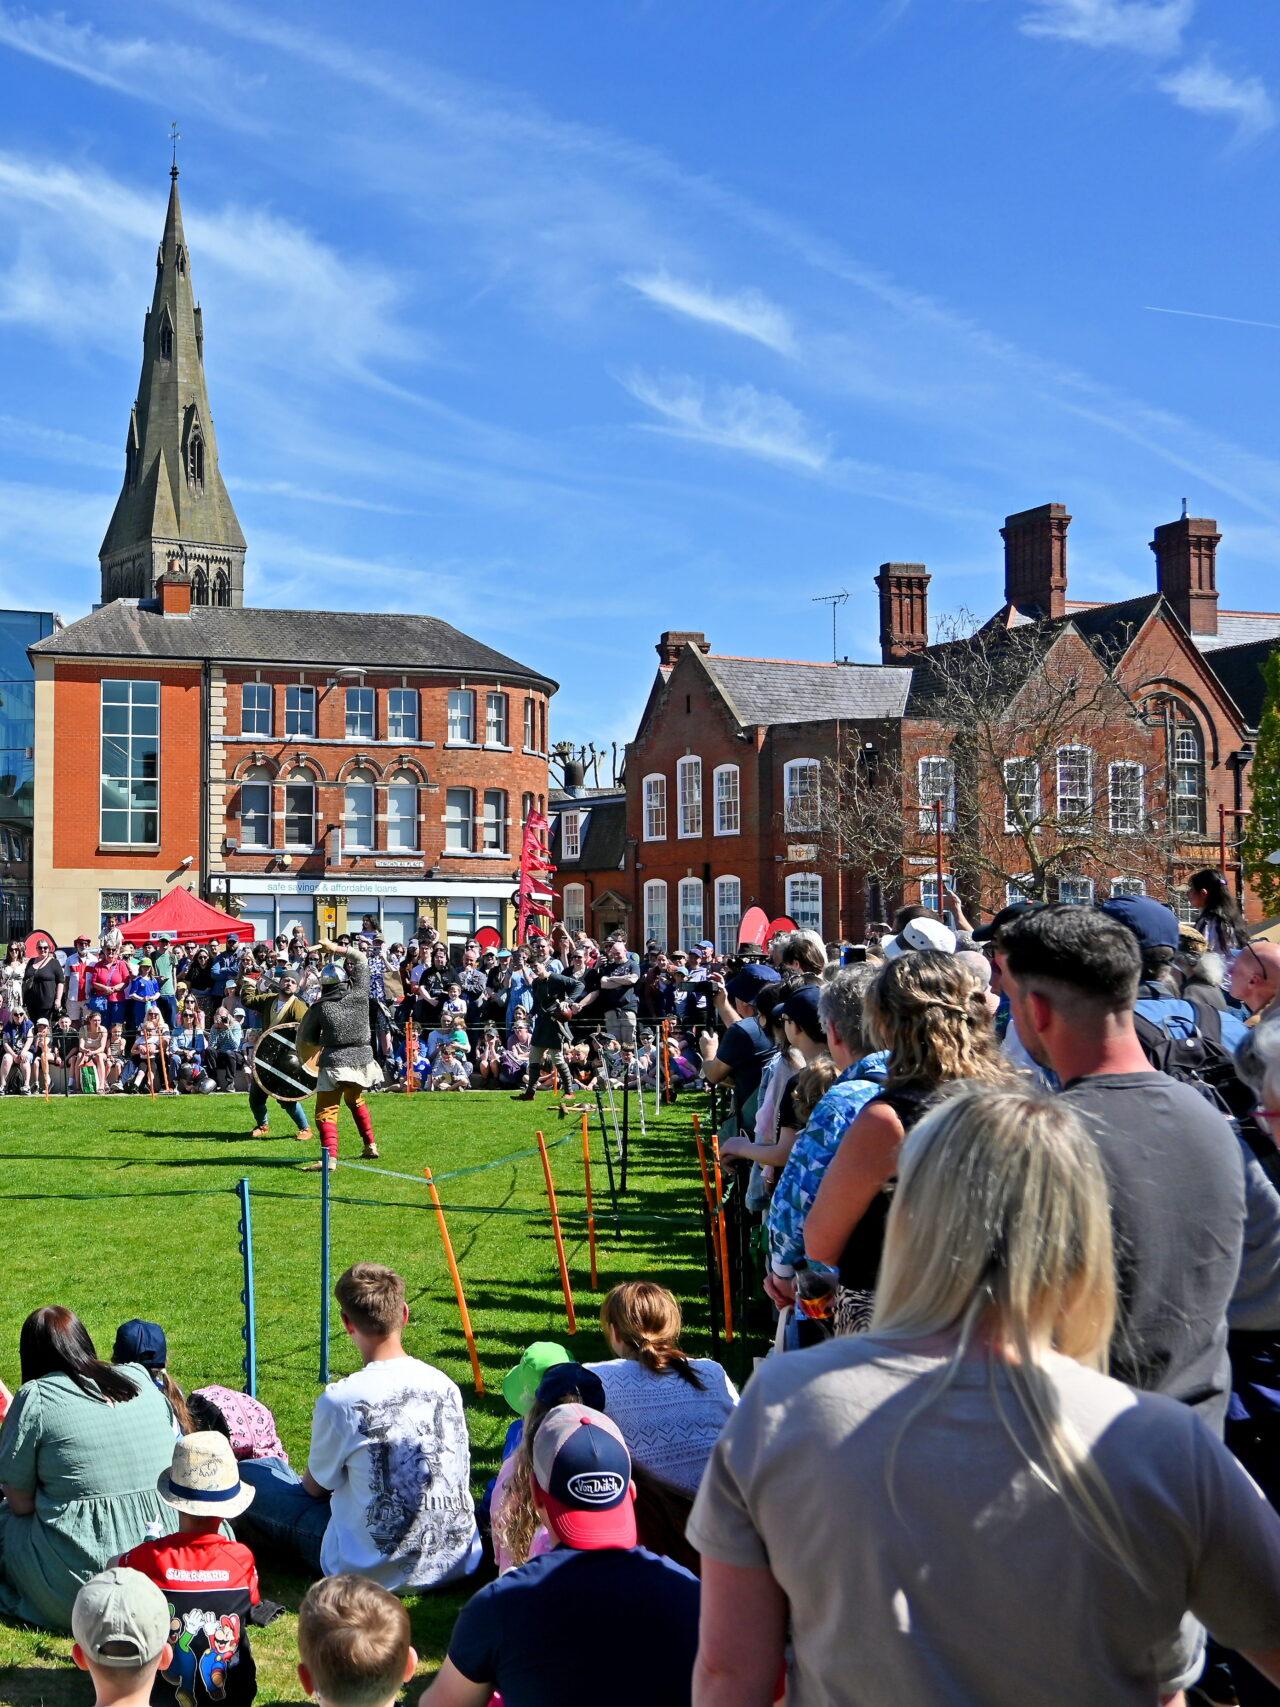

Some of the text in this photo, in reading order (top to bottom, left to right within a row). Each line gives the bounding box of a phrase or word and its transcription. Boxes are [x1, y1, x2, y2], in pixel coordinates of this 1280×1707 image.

[267, 882, 286, 891] safe
[288, 882, 320, 893] savings
[330, 883, 373, 893] affordable
[375, 884, 398, 893] loans
[575, 1477, 620, 1494] Von Dutch
[166, 1568, 229, 1581] SUPER MARIO
